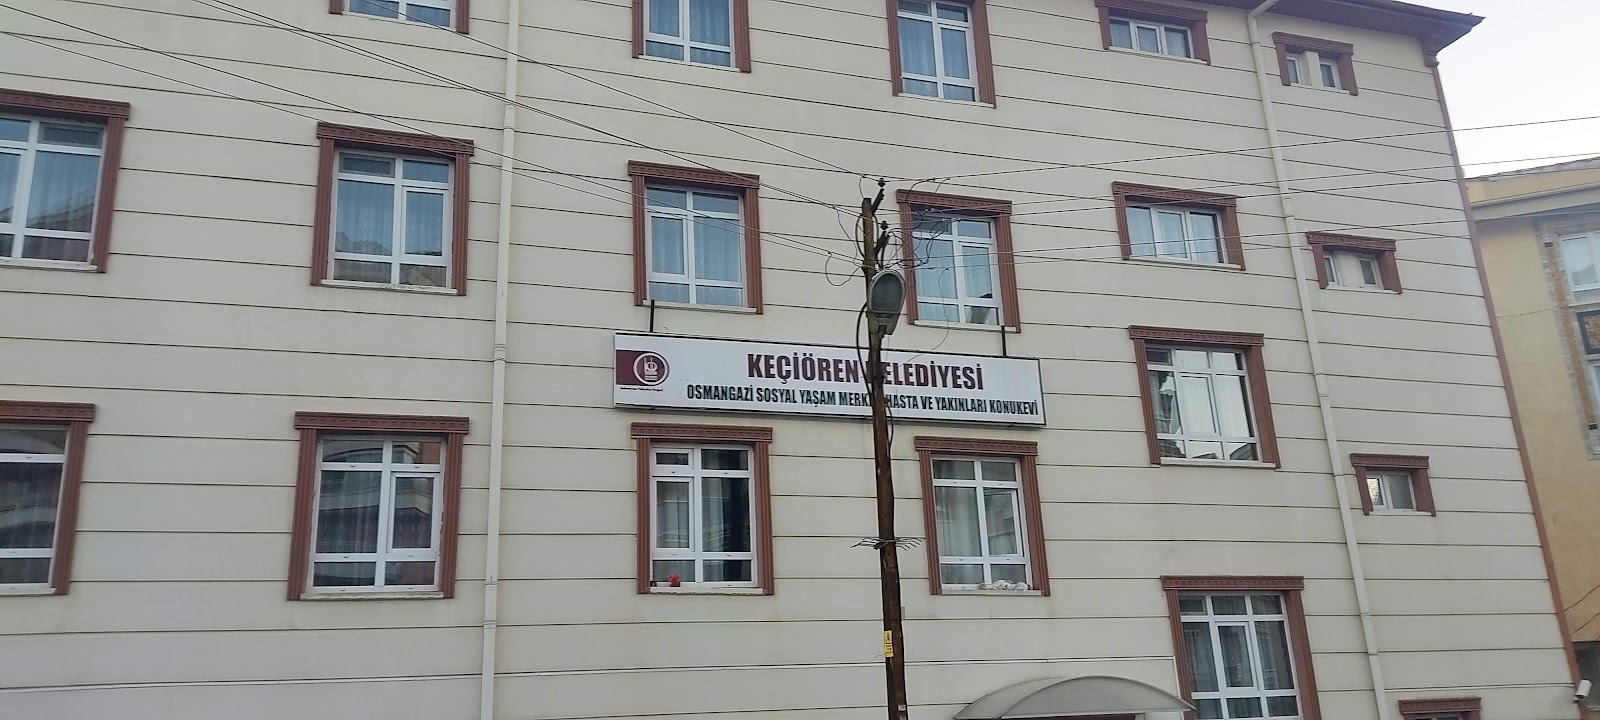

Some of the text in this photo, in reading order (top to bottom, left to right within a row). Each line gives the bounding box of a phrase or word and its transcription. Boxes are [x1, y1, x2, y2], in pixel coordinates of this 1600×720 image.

[747, 352, 984, 390] KEÇİÖREN ELEDİYESİ
[687, 384, 754, 401] OSMANGAZİ
[756, 389, 797, 403] SOSYAL
[800, 390, 836, 407] YAŞAM
[920, 396, 934, 410] VE
[935, 397, 988, 413] YAKINLARI
[989, 400, 1039, 416] KONUKEVİ
